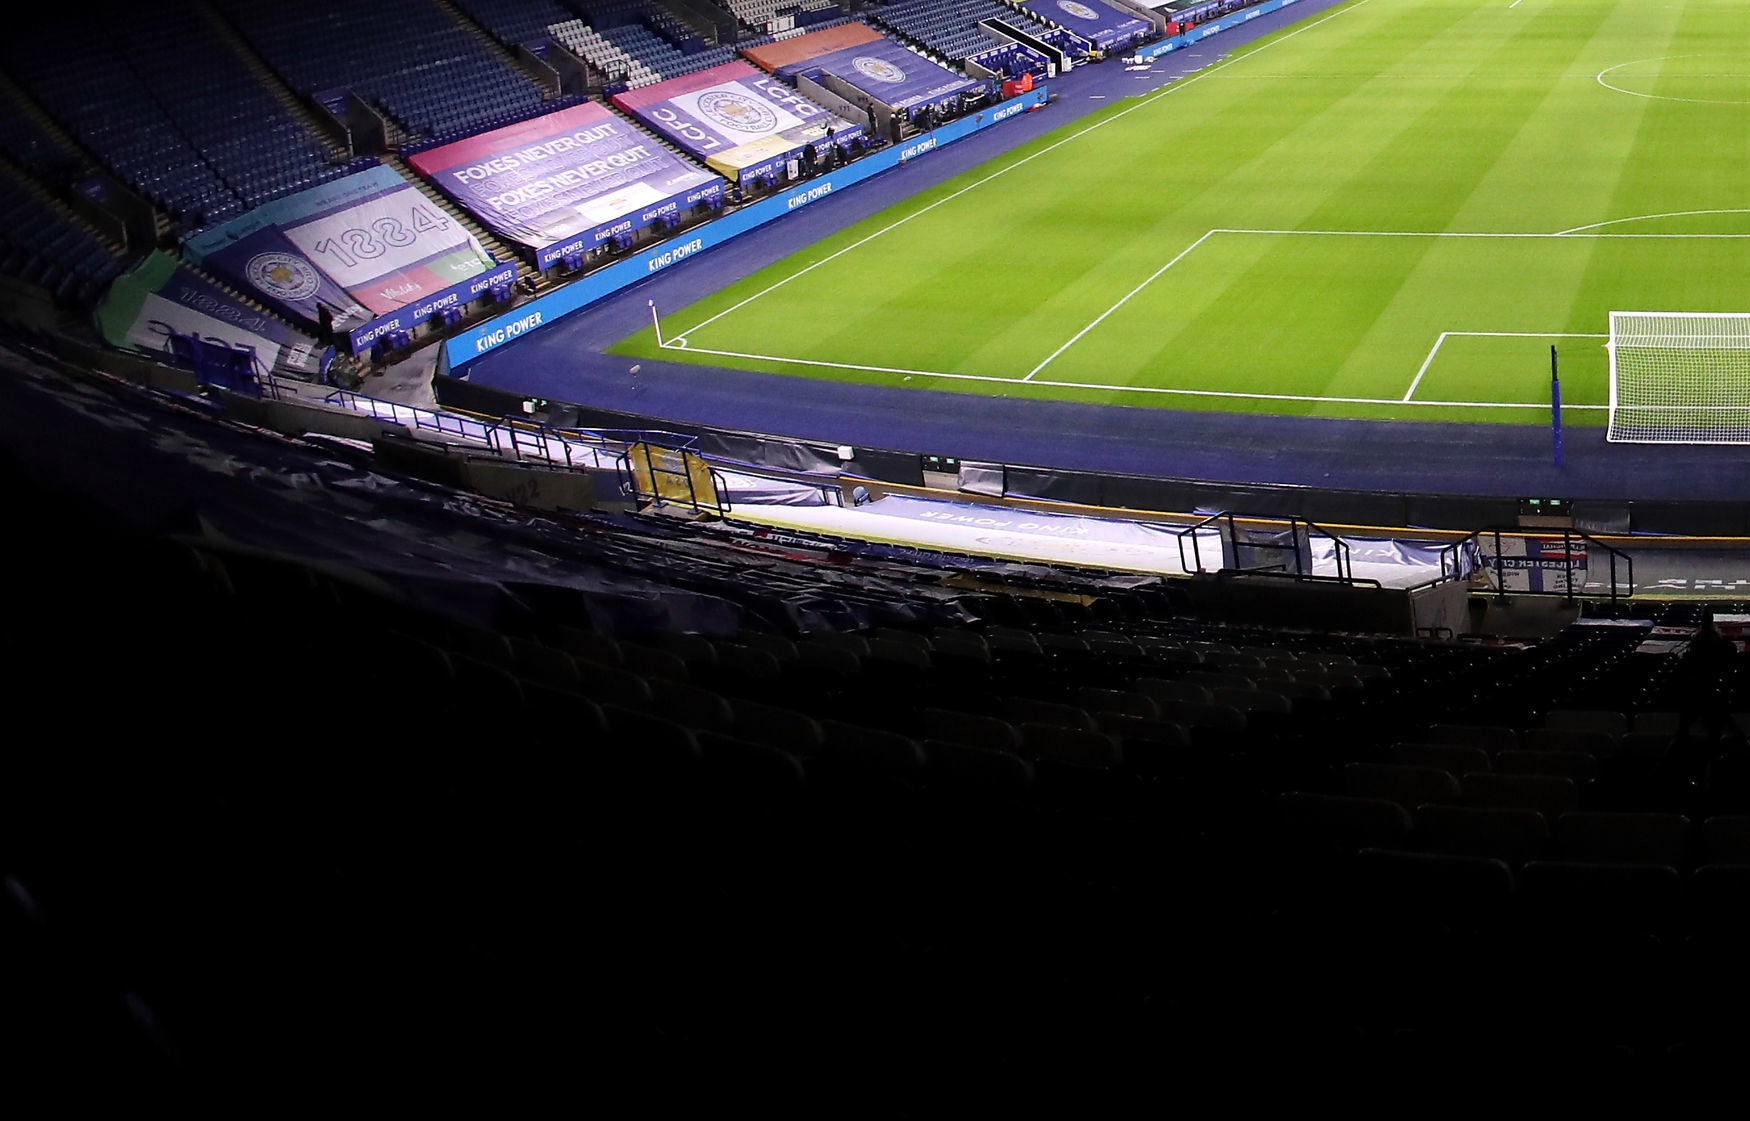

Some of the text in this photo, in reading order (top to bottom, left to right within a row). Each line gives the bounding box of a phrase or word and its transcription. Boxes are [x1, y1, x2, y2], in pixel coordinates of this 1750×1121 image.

[752, 79, 819, 116] LCFC
[994, 102, 1023, 121] KING POWER
[652, 107, 721, 150] LCFC
[453, 123, 618, 184] FOXES NEVER QUIT
[902, 137, 937, 160] KING POWER
[486, 145, 652, 211] FOXES NEVER QUIT
[742, 163, 772, 181] KING POWER
[687, 184, 720, 203] KING POWER
[788, 181, 832, 209] KING POWER
[642, 201, 677, 222] KING POWER
[315, 204, 450, 268] 1884
[594, 220, 632, 242] KING POWER
[544, 240, 584, 263] KING POWER
[649, 238, 703, 272] KING POWER
[470, 269, 513, 295] KING POWER
[413, 293, 458, 320] KING POWER
[356, 330, 375, 347] KING
[375, 318, 400, 339] POWER
[476, 312, 543, 353] KING POWER
[918, 509, 1011, 527] POWER
